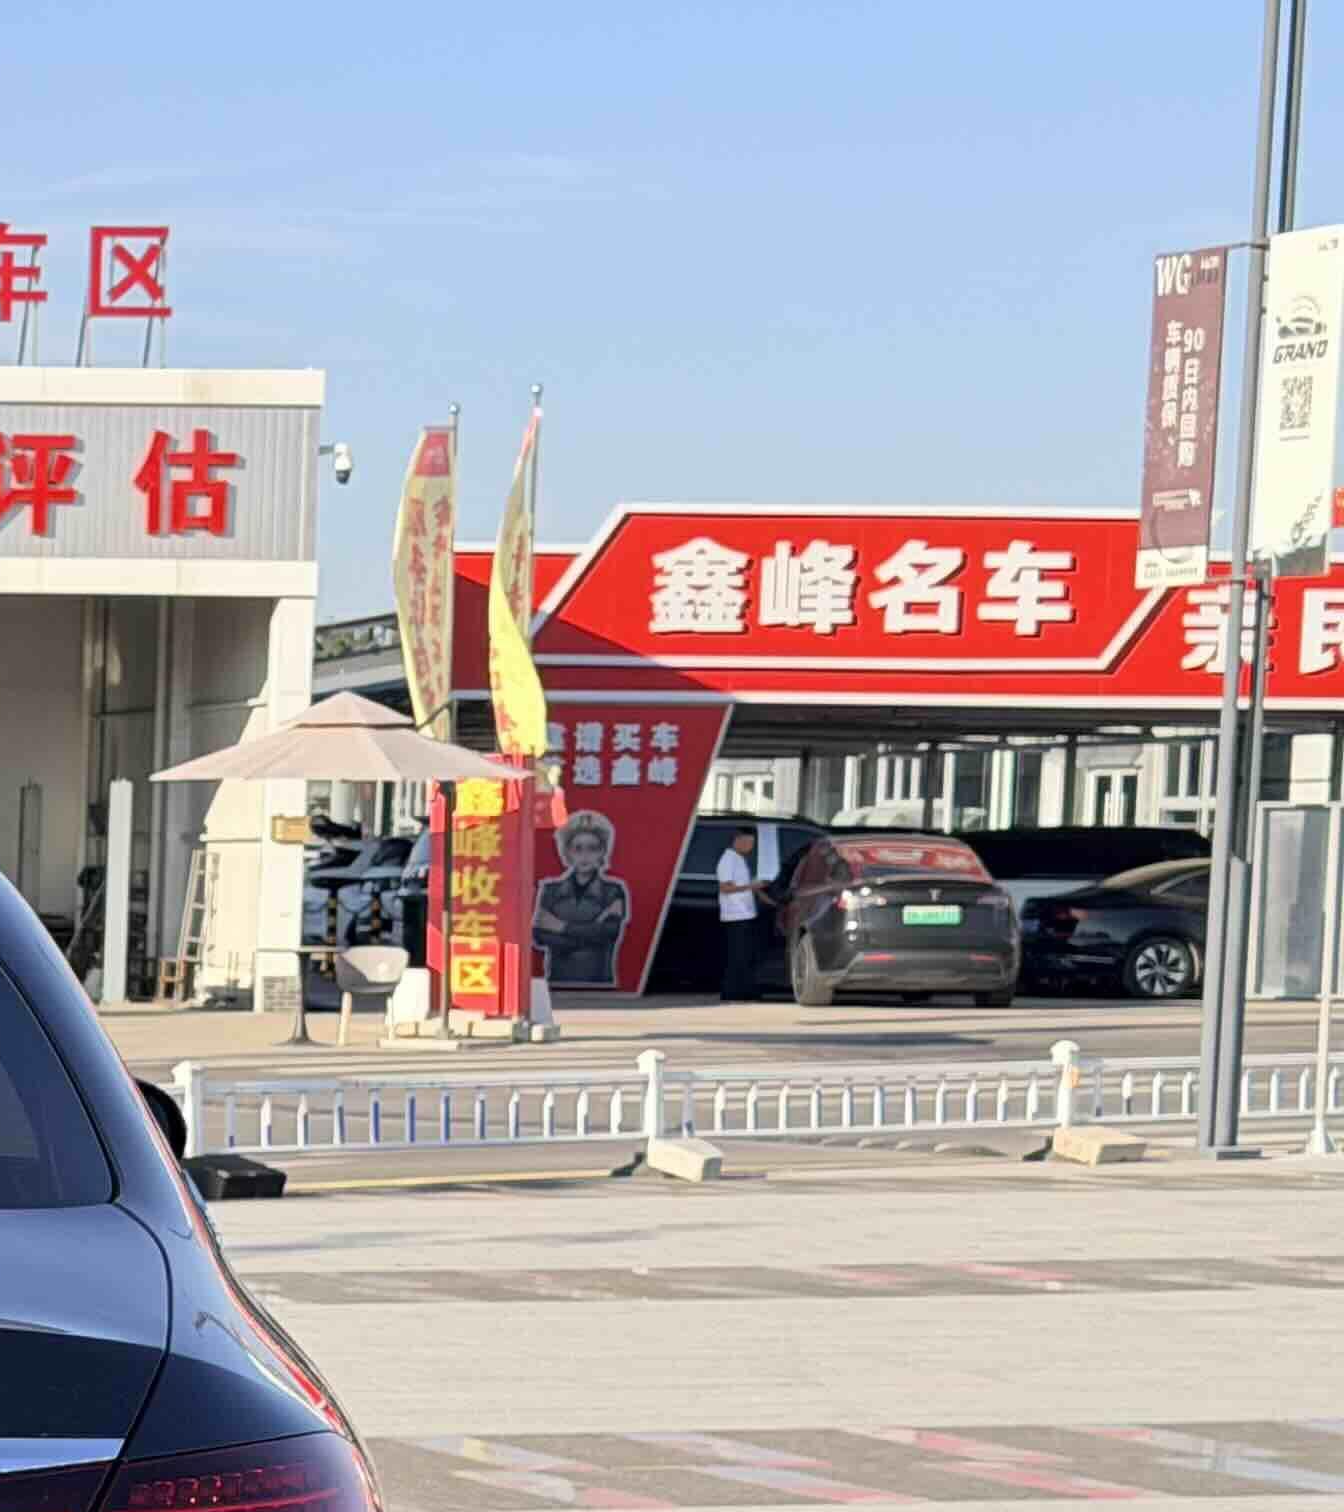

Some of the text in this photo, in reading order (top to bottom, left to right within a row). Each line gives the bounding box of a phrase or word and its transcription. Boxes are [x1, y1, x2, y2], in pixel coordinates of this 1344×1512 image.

[1273, 340, 1328, 364] GRAND
[648, 537, 1076, 637] 鑫峰名车
